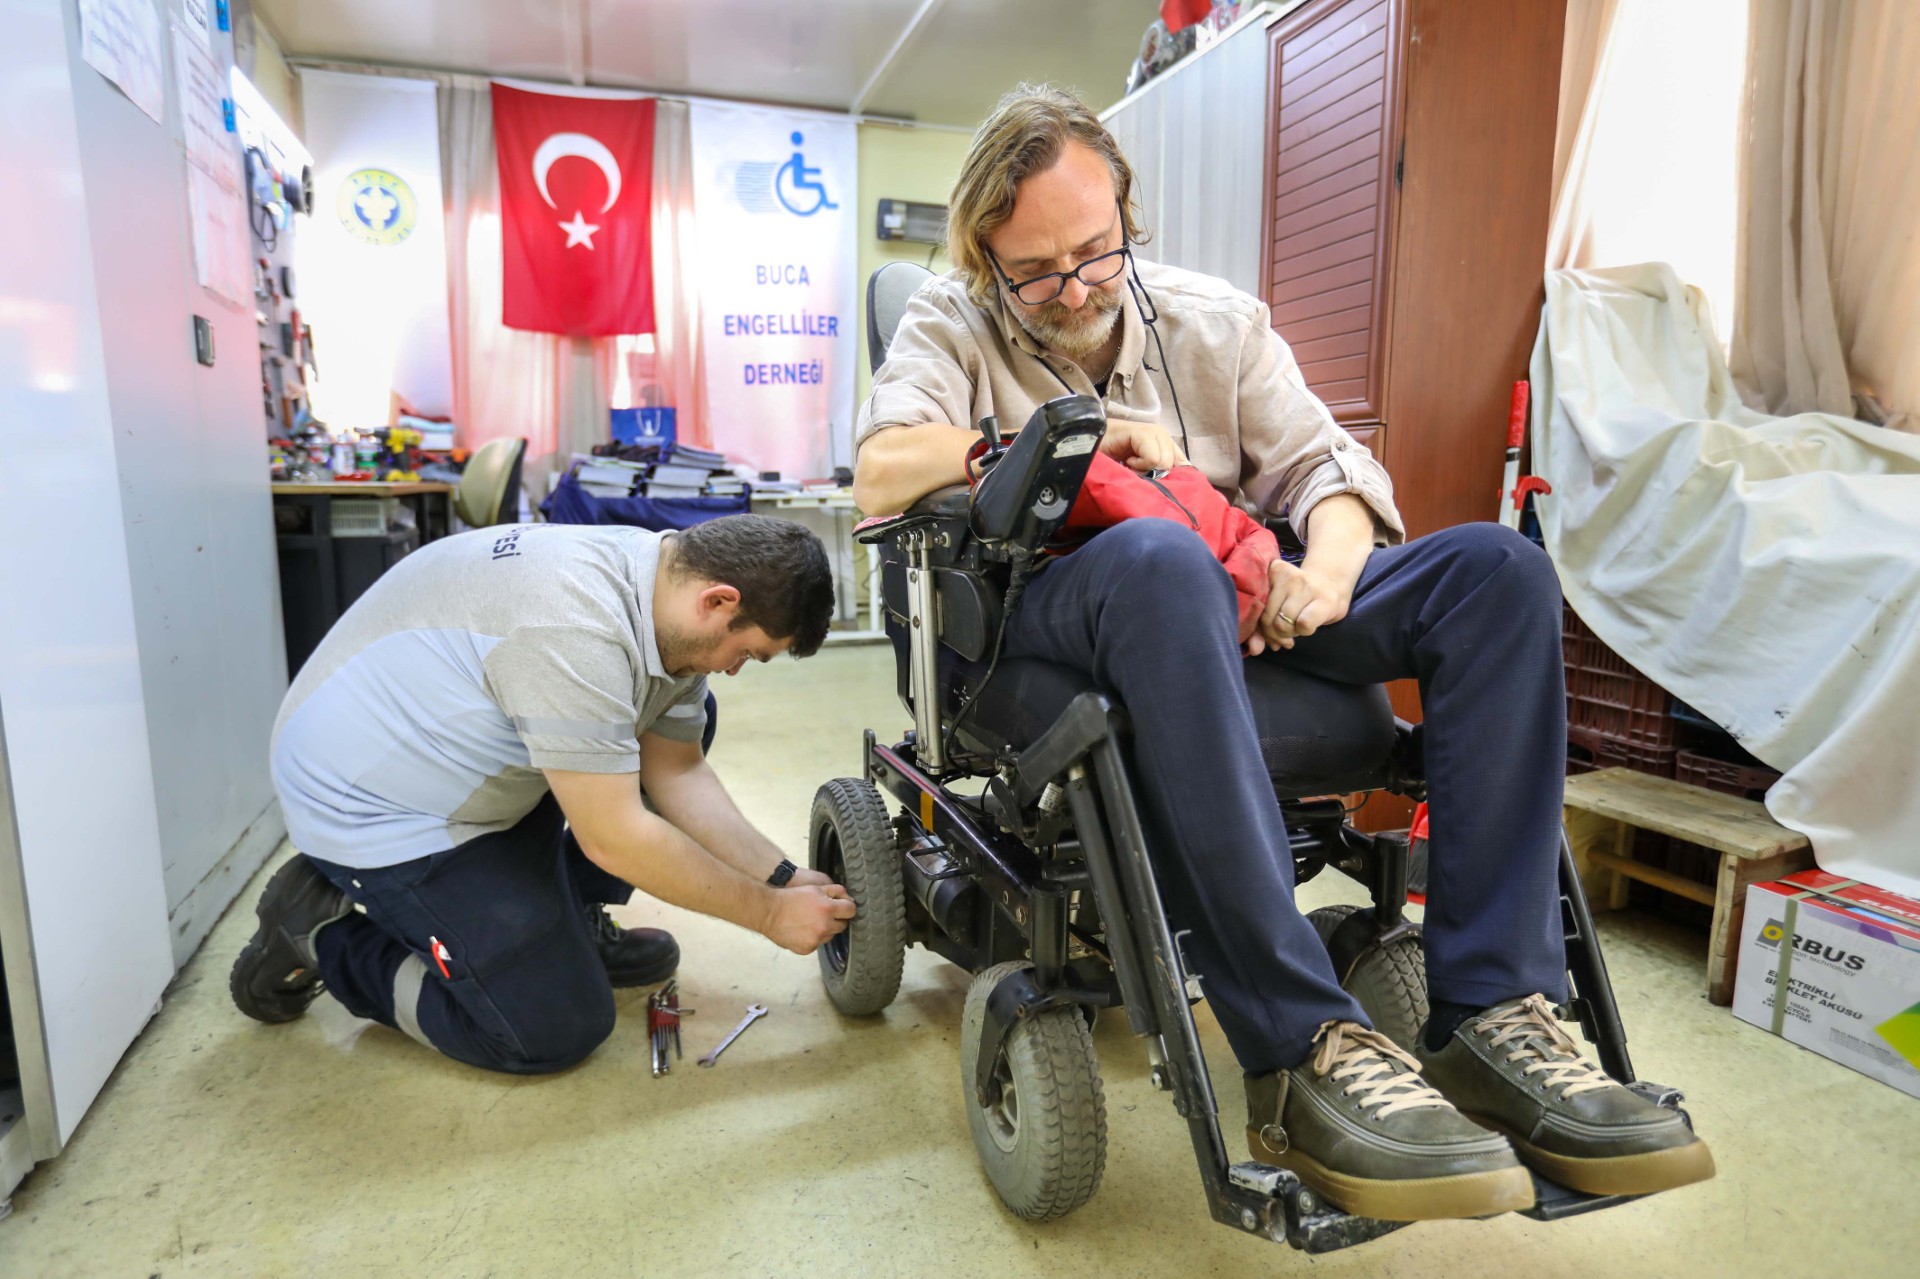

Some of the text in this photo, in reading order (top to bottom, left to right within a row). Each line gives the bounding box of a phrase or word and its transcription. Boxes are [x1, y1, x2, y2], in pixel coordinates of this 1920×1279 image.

[755, 264, 811, 286] BUCA
[723, 308, 839, 338] ENGELLİLER
[743, 358, 824, 386] DERNEĞİ
[1762, 925, 1866, 971] ORBUS
